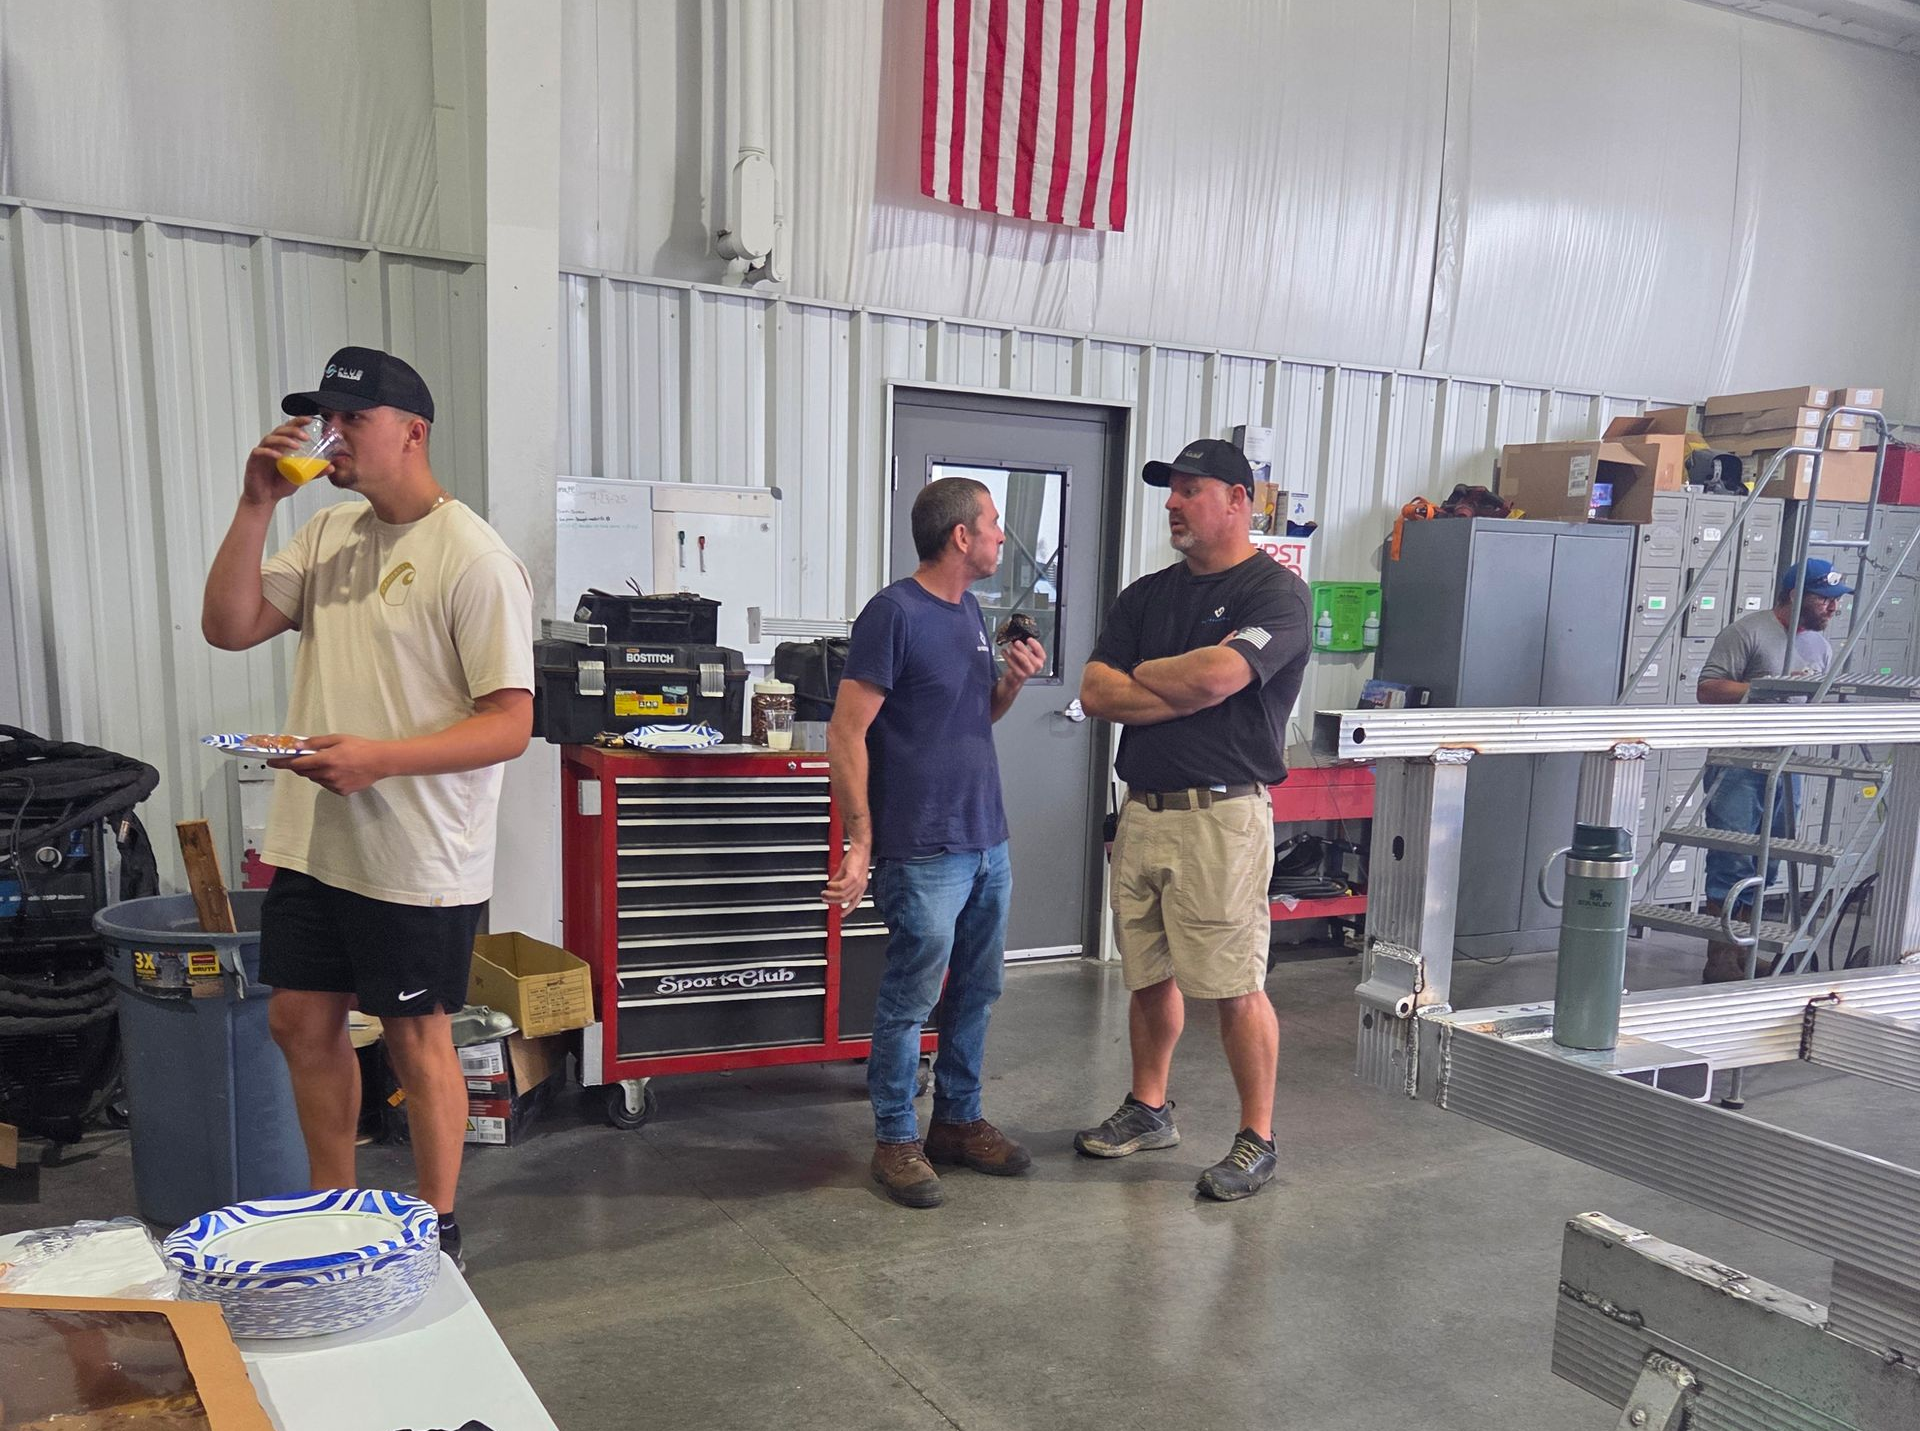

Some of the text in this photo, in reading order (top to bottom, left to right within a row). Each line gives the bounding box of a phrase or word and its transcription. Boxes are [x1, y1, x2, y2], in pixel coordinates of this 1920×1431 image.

[1250, 543, 1306, 565] RST
[626, 653, 674, 663] BOSTITCH
[134, 951, 156, 970] 3X
